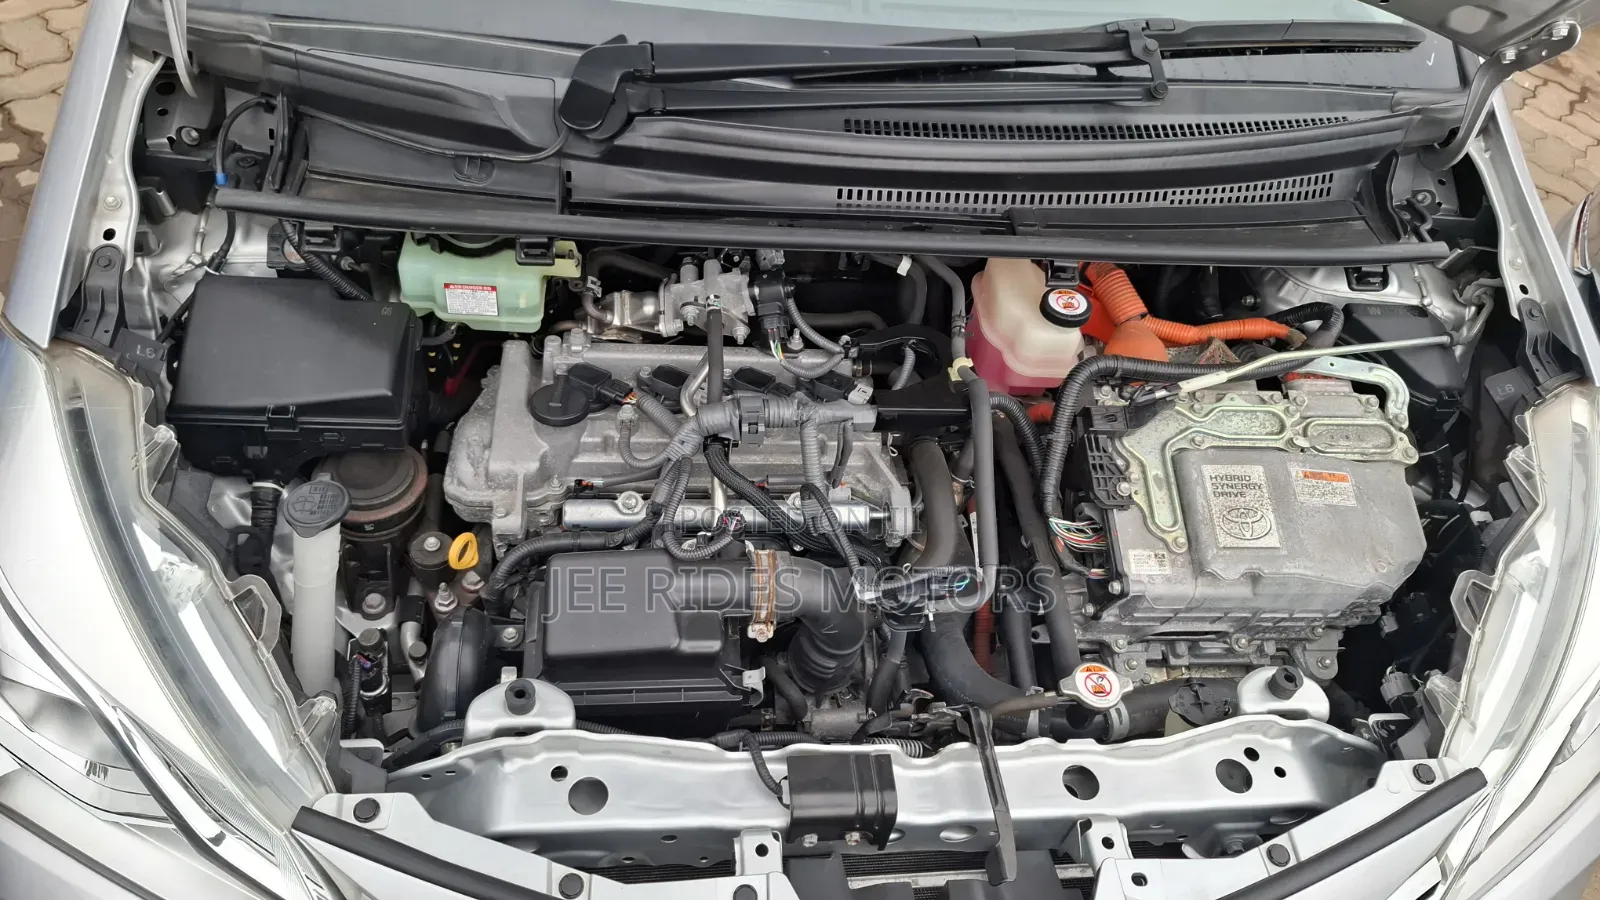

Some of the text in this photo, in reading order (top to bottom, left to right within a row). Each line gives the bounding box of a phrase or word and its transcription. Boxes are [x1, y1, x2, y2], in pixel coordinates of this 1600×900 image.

[136, 344, 155, 359] L6
[1209, 474, 1252, 482] HYBRID
[1211, 482, 1263, 490] SYNERGY
